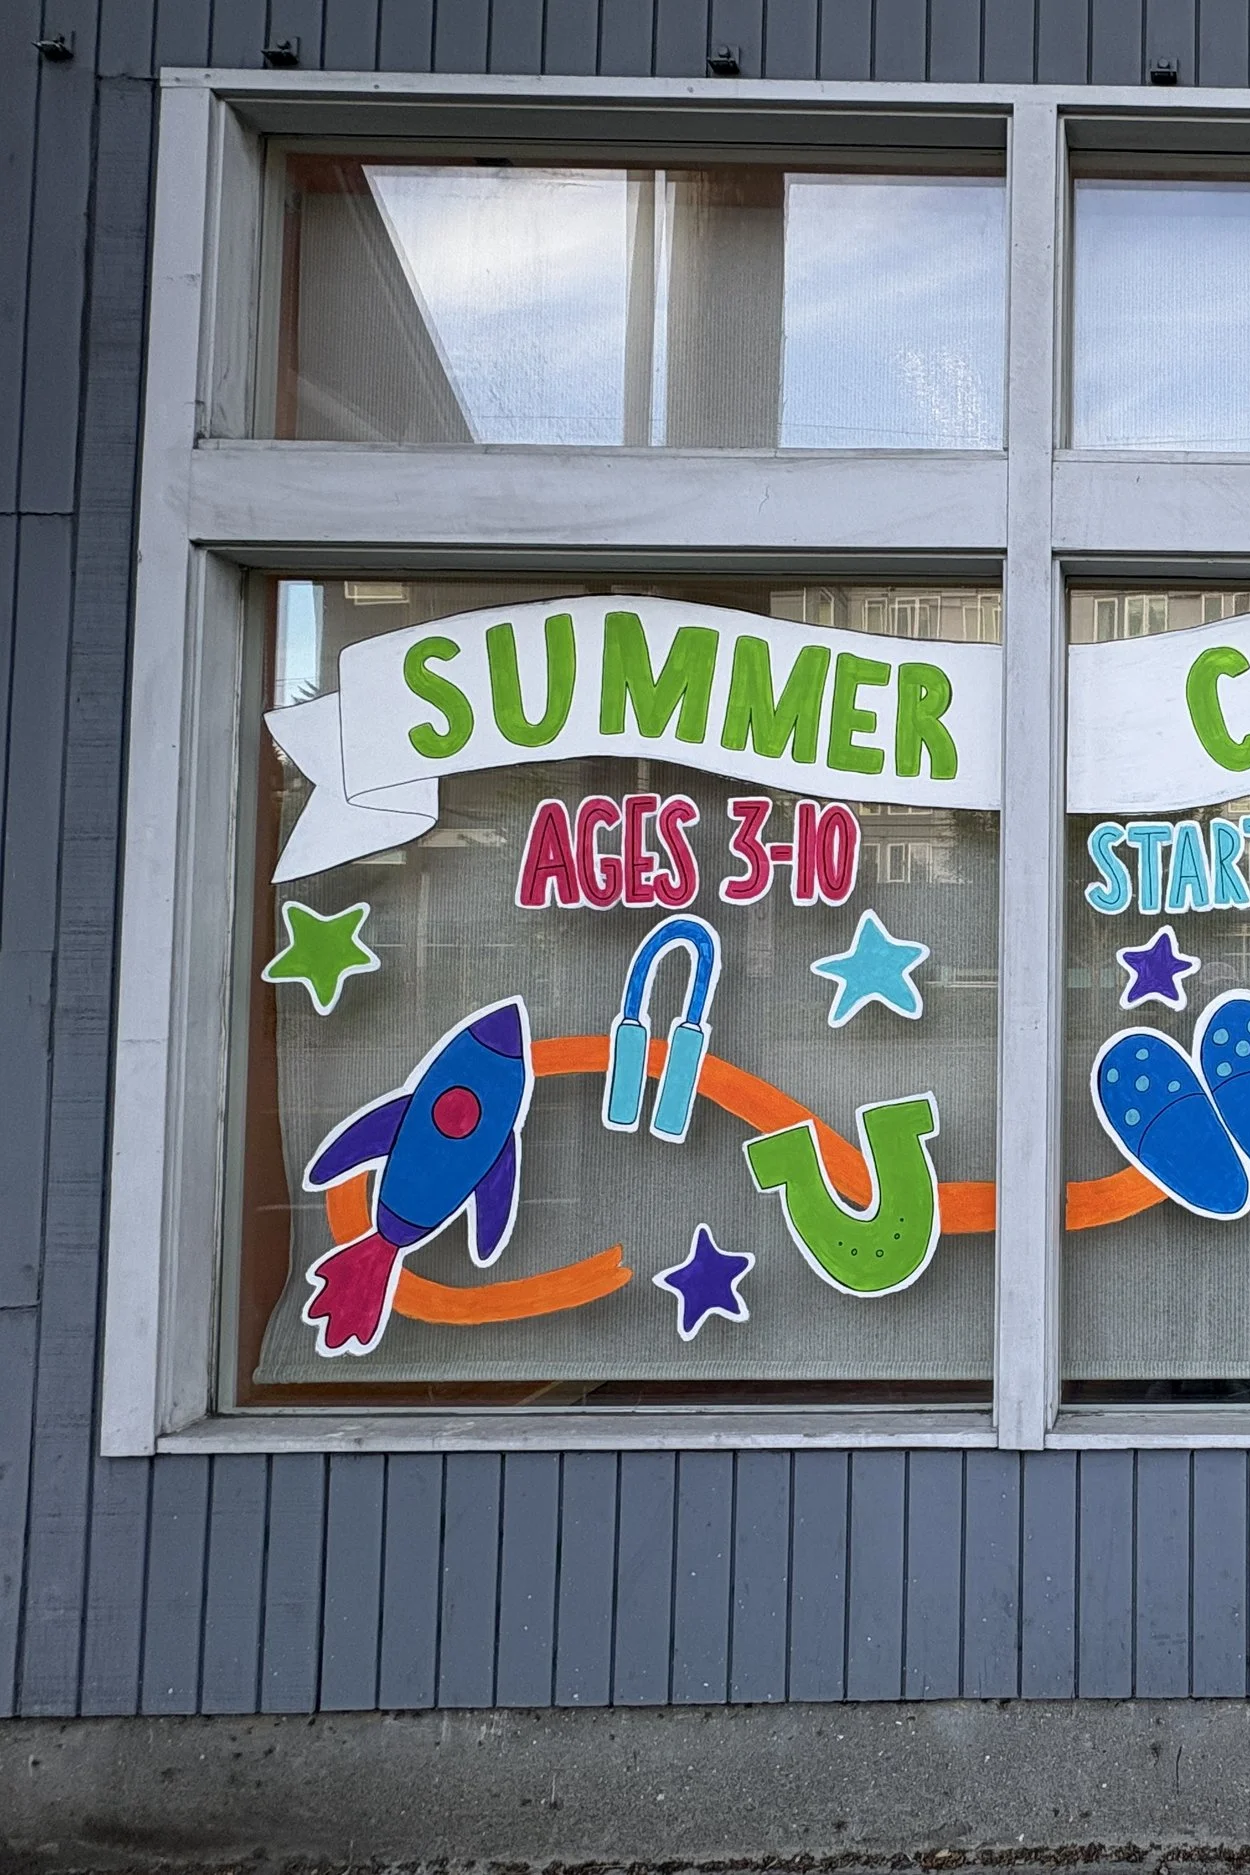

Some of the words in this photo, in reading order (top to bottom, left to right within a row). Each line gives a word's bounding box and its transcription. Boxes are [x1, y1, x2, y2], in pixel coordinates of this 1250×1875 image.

[402, 612, 958, 780] SUMMER
[517, 795, 700, 909] AGES
[721, 798, 861, 906] 3-10
